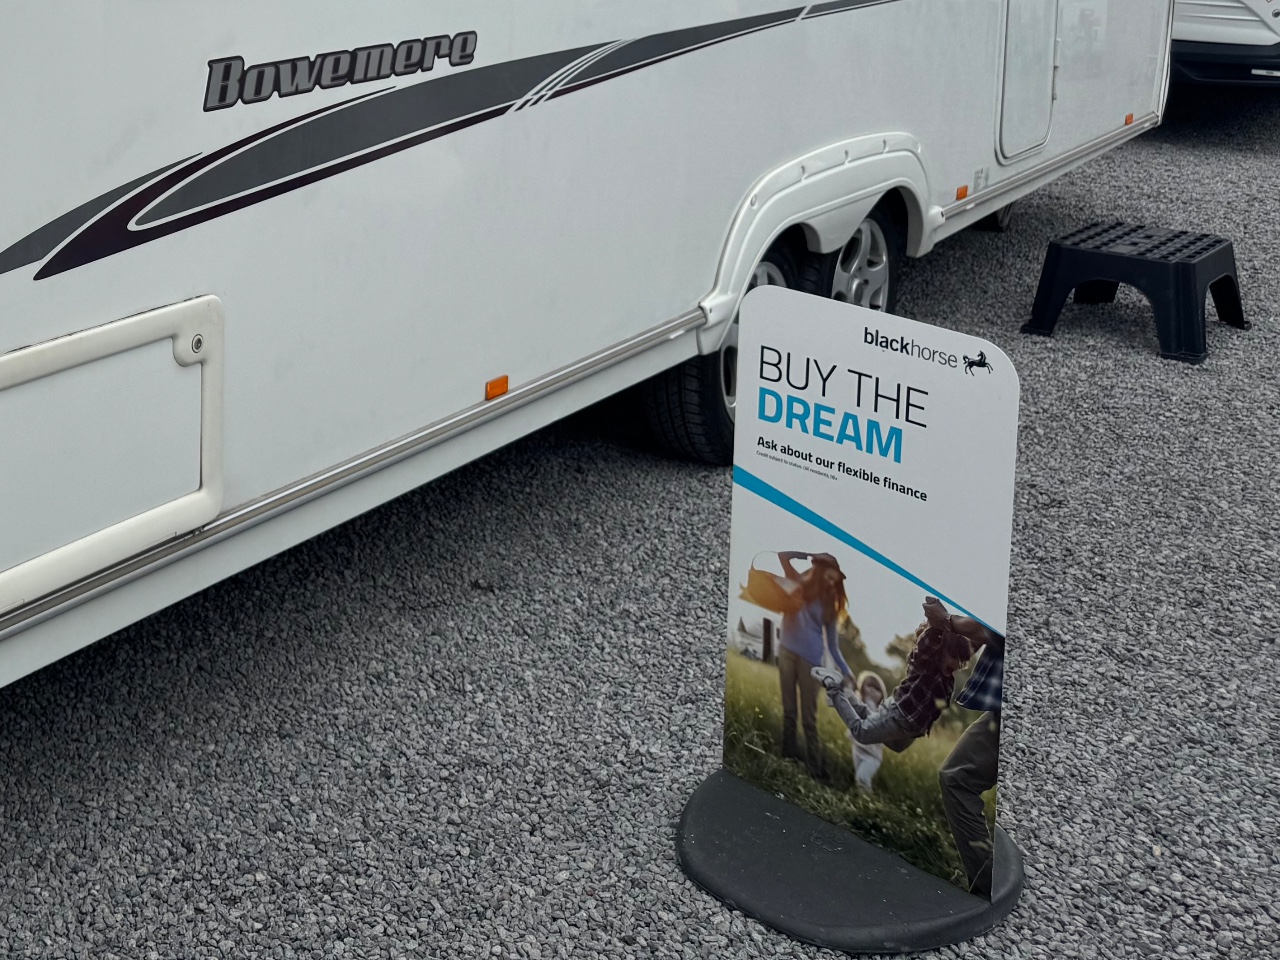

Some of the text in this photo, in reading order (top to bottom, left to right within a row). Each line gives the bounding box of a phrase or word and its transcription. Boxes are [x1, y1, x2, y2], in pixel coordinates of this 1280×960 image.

[202, 30, 478, 112] Bowemere
[863, 326, 958, 368] blackhorse
[759, 345, 929, 428] BUY THE
[757, 386, 903, 464] DREAM
[768, 454, 783, 464] subject
[757, 436, 928, 502] Ask about our flexible finance
